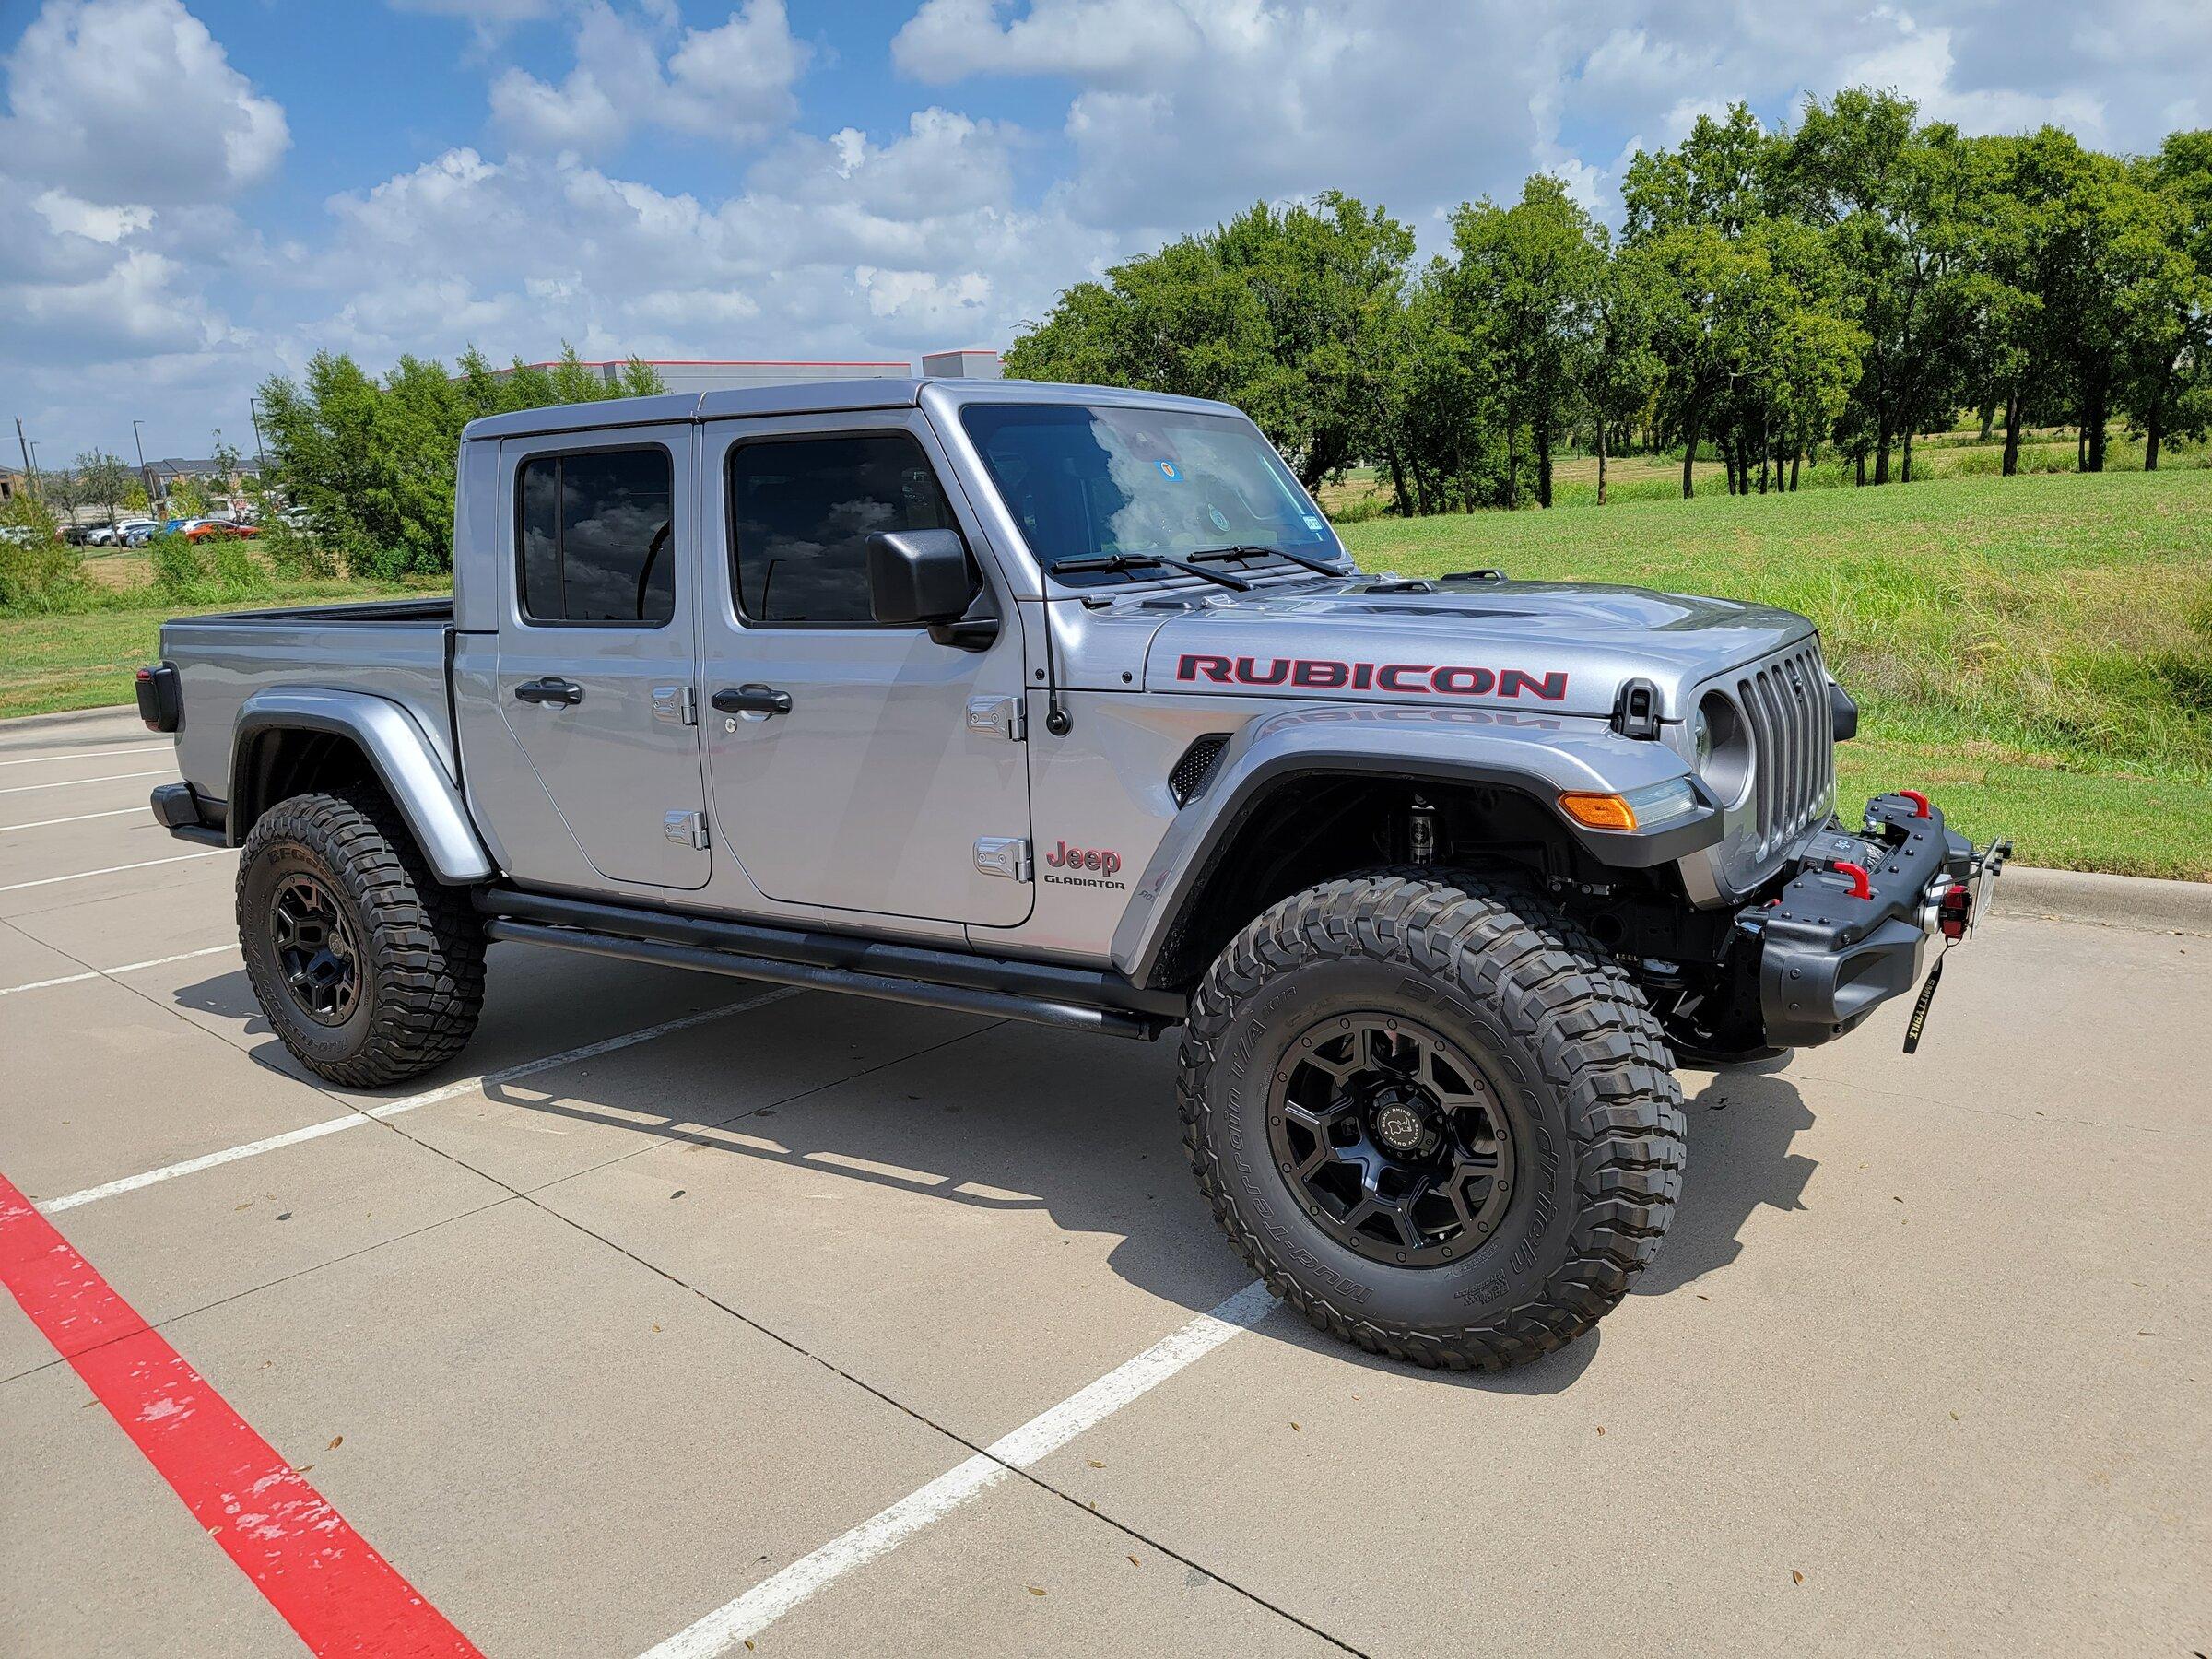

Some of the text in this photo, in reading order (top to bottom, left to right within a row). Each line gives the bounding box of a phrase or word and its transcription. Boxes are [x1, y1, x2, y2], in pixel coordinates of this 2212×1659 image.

[1176, 653, 1570, 701] RUBICON
[1043, 874, 1125, 890] GLADIATOR
[1046, 840, 1122, 877] Jeep
[1395, 977, 1560, 1274] BFGoodrich
[1223, 1087, 1374, 1304] Mud-Terrain
